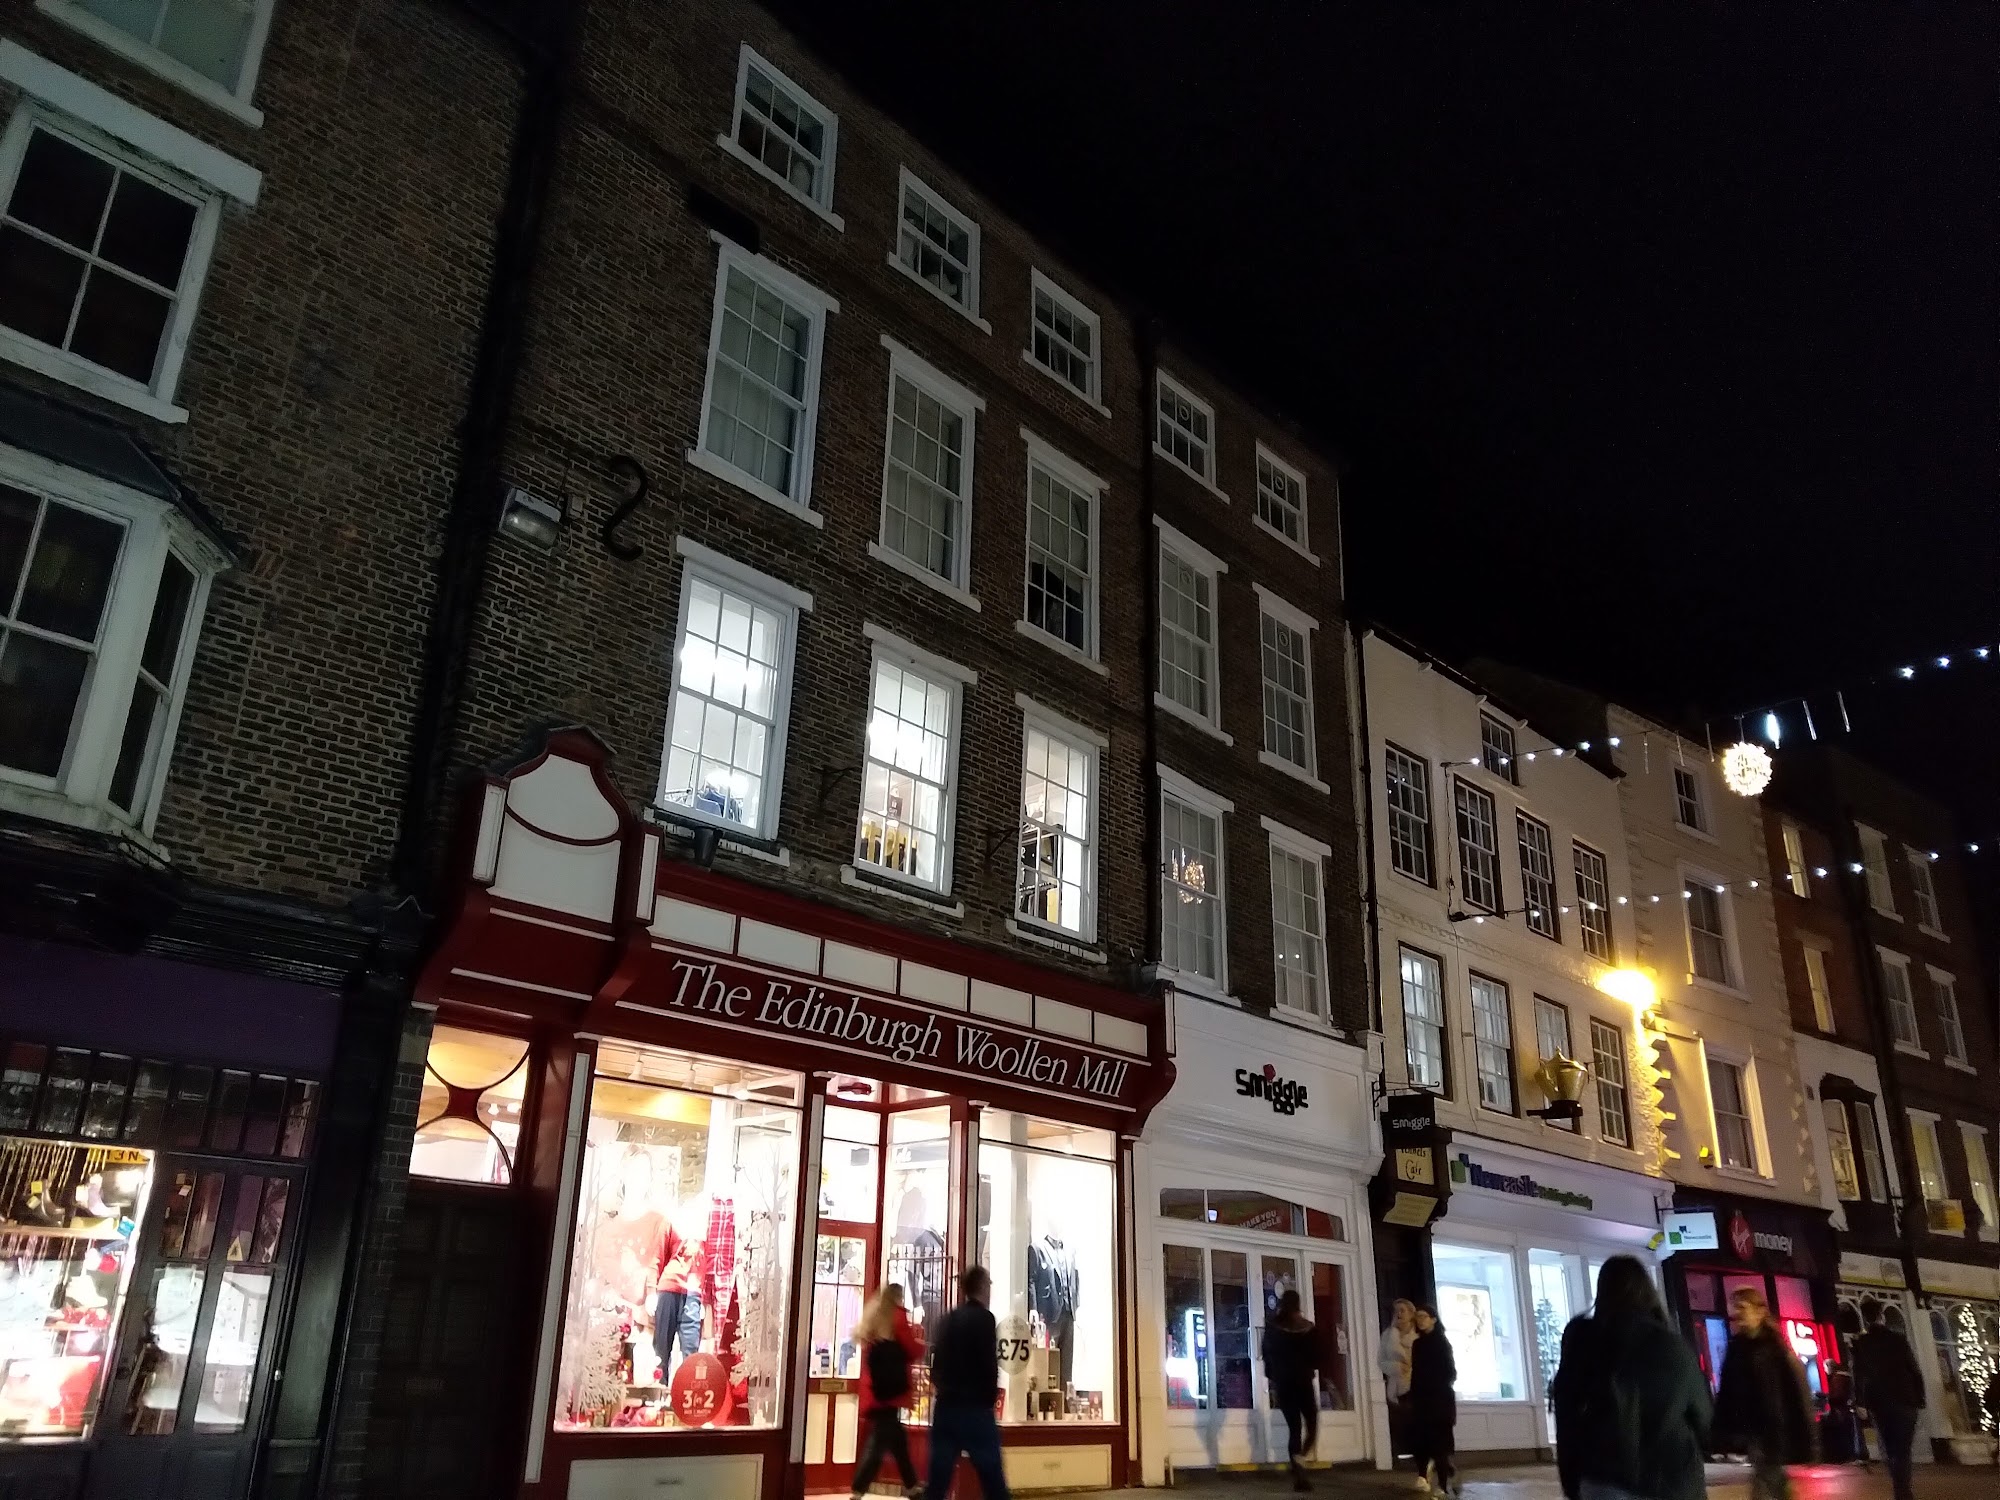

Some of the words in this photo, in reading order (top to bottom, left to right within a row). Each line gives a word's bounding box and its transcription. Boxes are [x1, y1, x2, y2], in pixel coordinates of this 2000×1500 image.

[670, 959, 752, 1018] The
[755, 980, 942, 1063] Edinburgh
[956, 1024, 1069, 1086] Woollen
[1072, 1055, 1130, 1098] Mill
[1235, 1063, 1309, 1116] smiggle
[1392, 1116, 1431, 1131] smiggle
[1753, 1231, 1793, 1257] money
[997, 1338, 1030, 1361] £75
[682, 1390, 693, 1408] 3
[704, 1390, 714, 1408] 2
